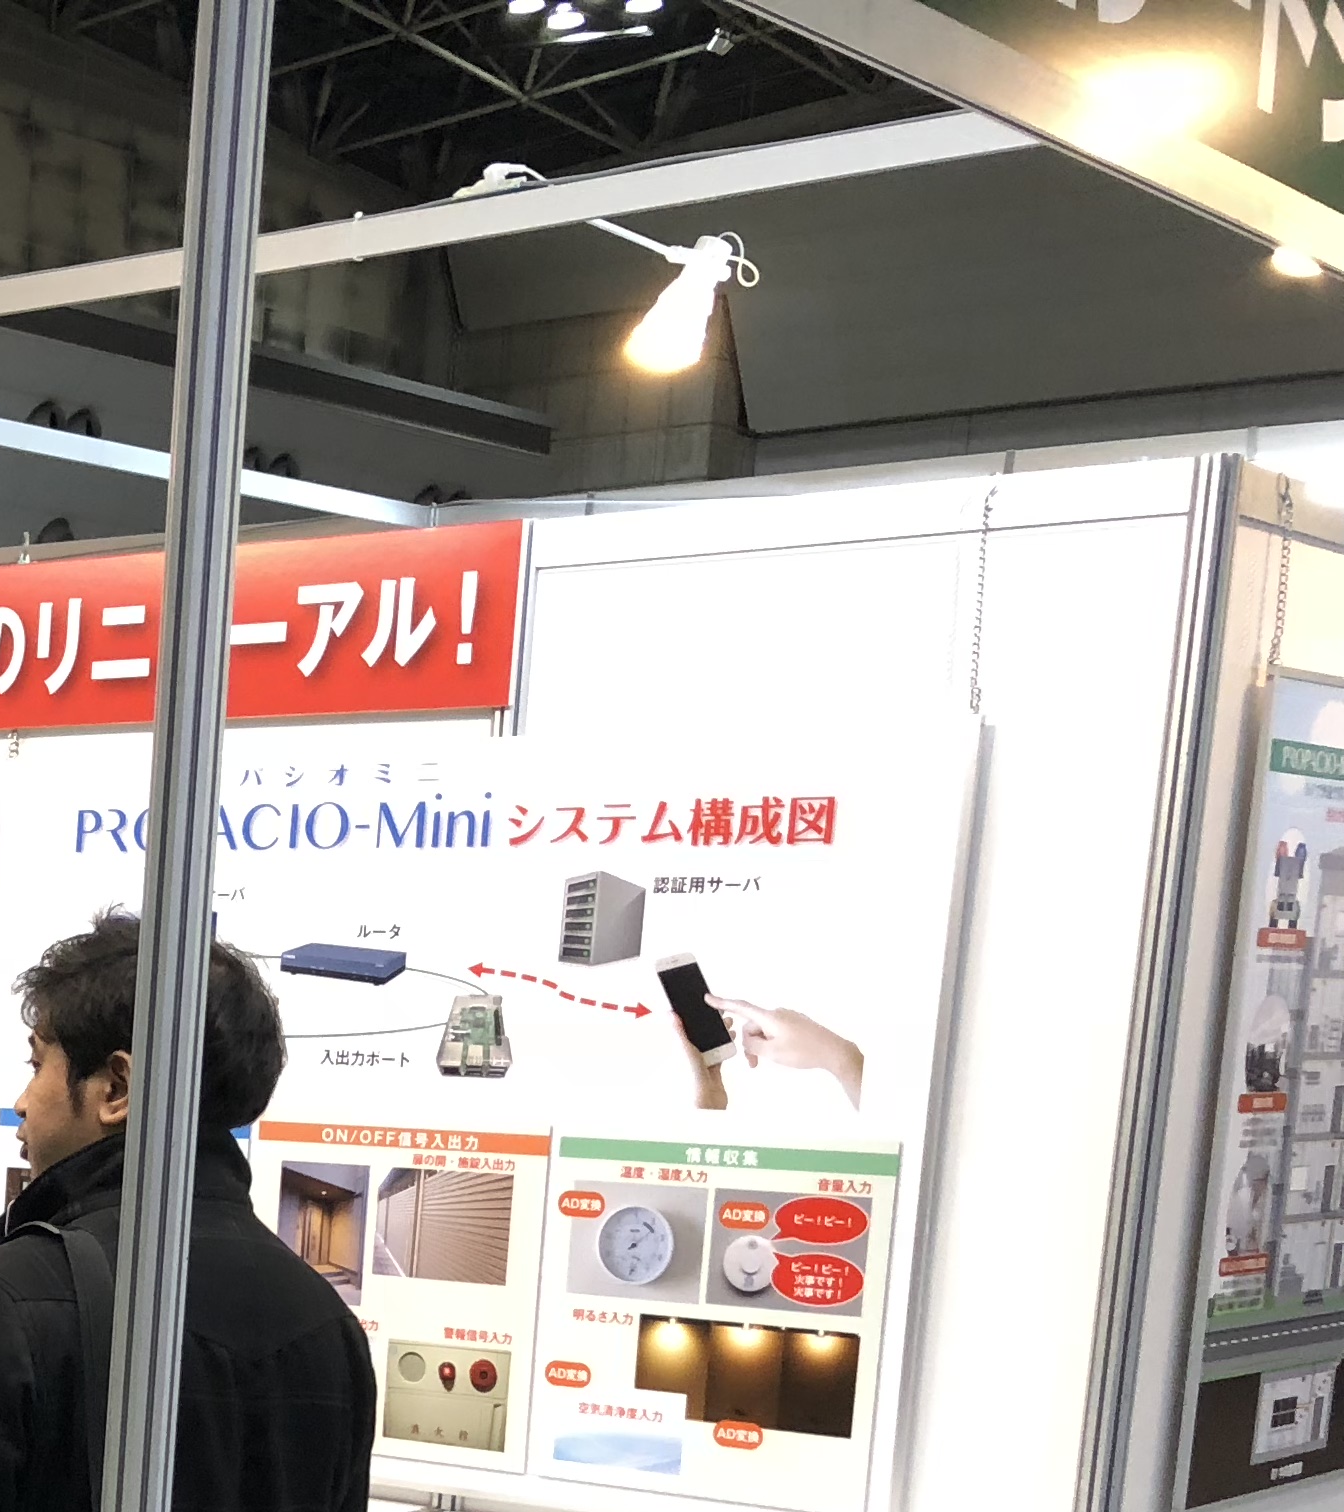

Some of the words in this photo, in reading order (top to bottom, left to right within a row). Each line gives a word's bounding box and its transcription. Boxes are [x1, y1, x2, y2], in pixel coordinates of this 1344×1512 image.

[75, 791, 493, 854] PRACIO-Mini
[505, 796, 839, 852] システム構成図
[652, 873, 762, 894] 認証用サーバ
[212, 887, 246, 901] ーバ
[356, 922, 403, 940] ルータ
[319, 1049, 412, 1067] 入出力ポート
[320, 1127, 480, 1152] ON/OFF信号入出力
[685, 1147, 760, 1167] 情報収集
[816, 1178, 873, 1195] 音量入力
[572, 1308, 634, 1326] 明るさ入力
